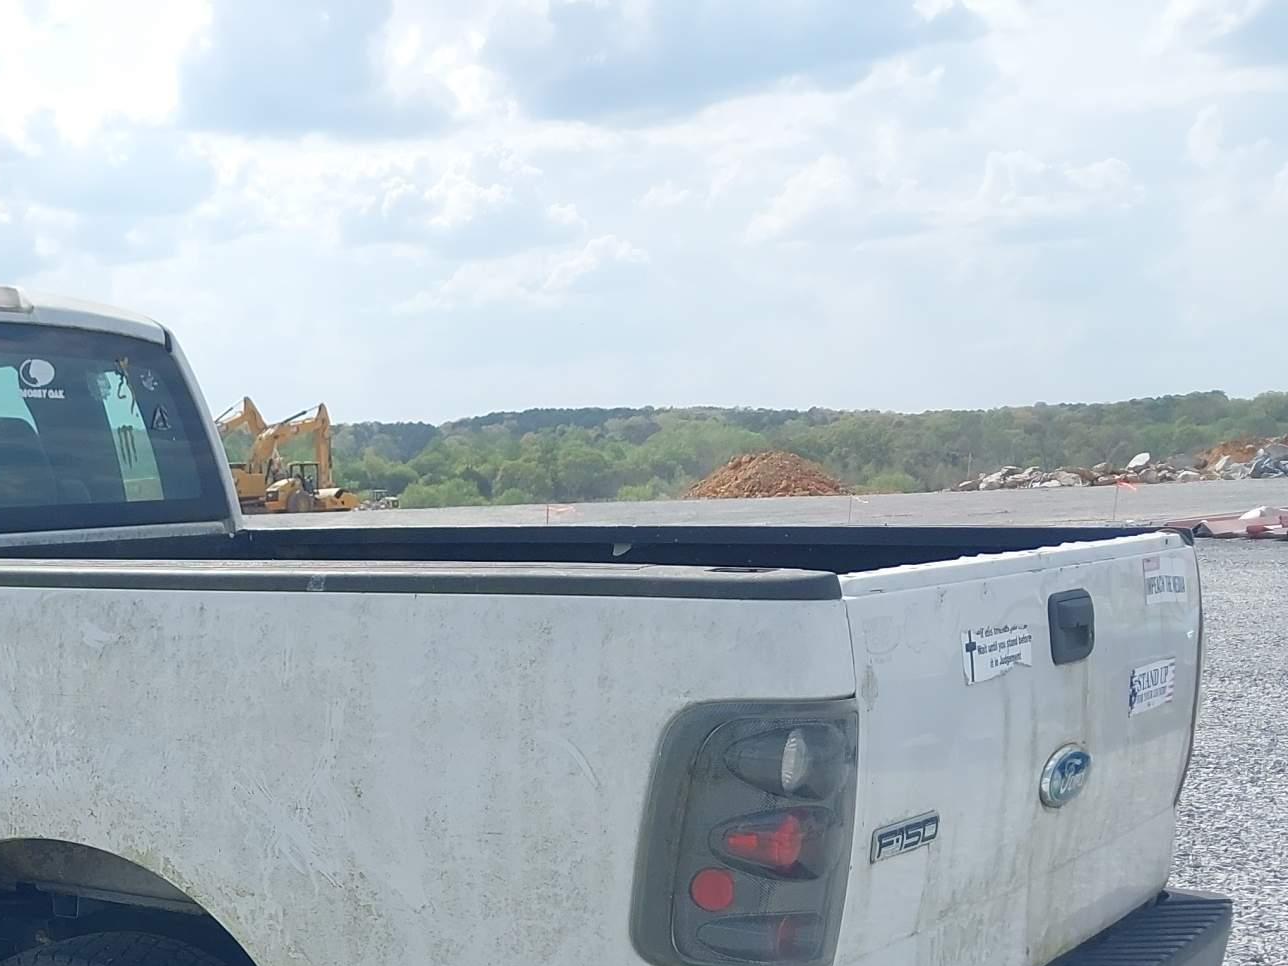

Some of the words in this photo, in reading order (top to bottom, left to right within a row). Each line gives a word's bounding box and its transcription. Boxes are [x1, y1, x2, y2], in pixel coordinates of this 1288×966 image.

[48, 389, 65, 399] OAK
[1134, 668, 1159, 693] STAND
[1160, 665, 1169, 684] UP
[876, 814, 939, 860] F150
